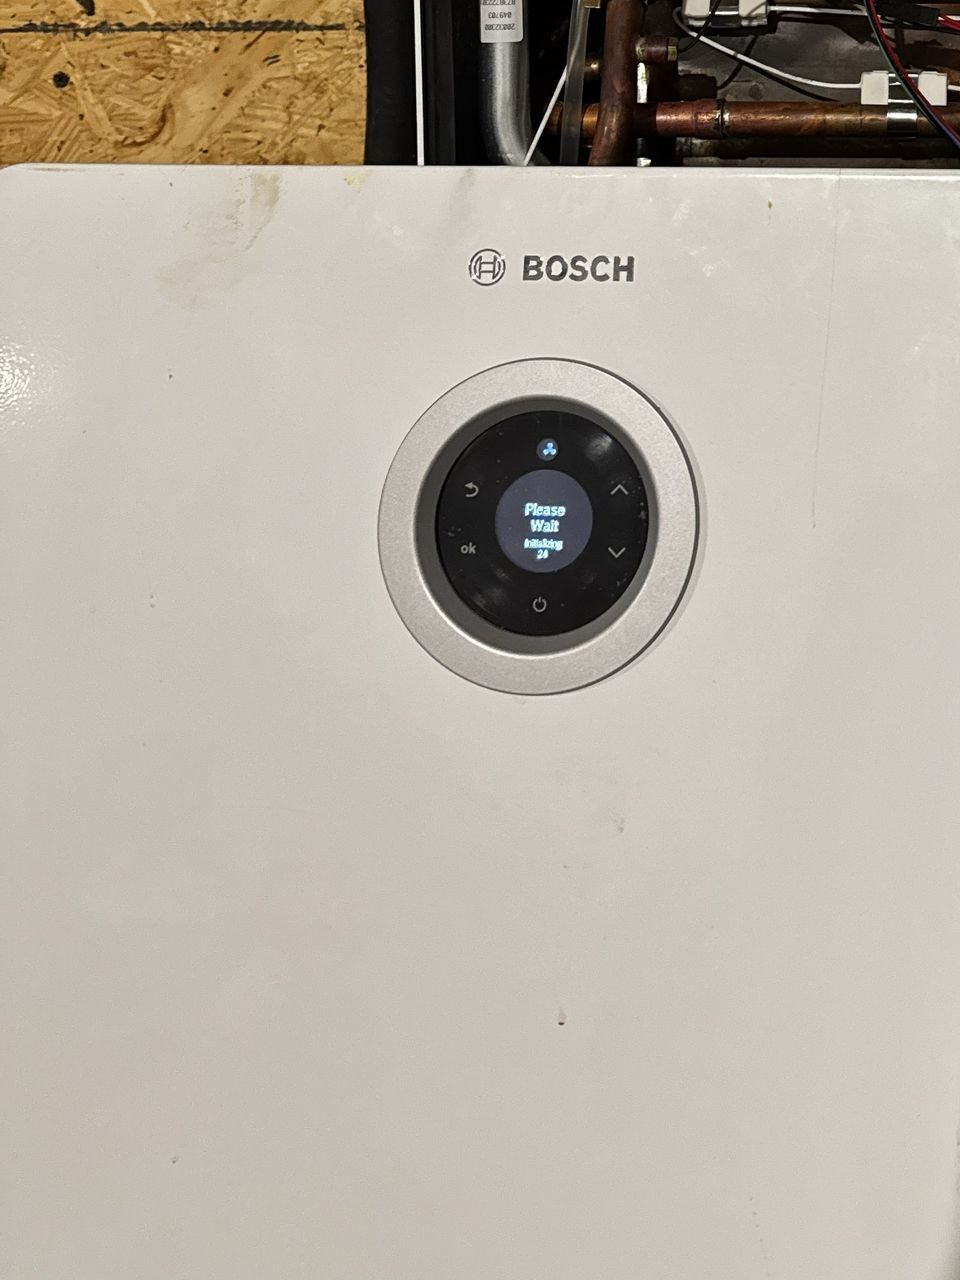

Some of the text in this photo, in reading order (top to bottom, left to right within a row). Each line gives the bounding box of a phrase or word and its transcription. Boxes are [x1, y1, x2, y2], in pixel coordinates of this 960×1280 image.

[522, 255, 635, 282] BOSCH
[524, 502, 566, 517] Please
[530, 519, 560, 533] Wait
[460, 542, 477, 554] ok
[523, 538, 564, 552] Initializing
